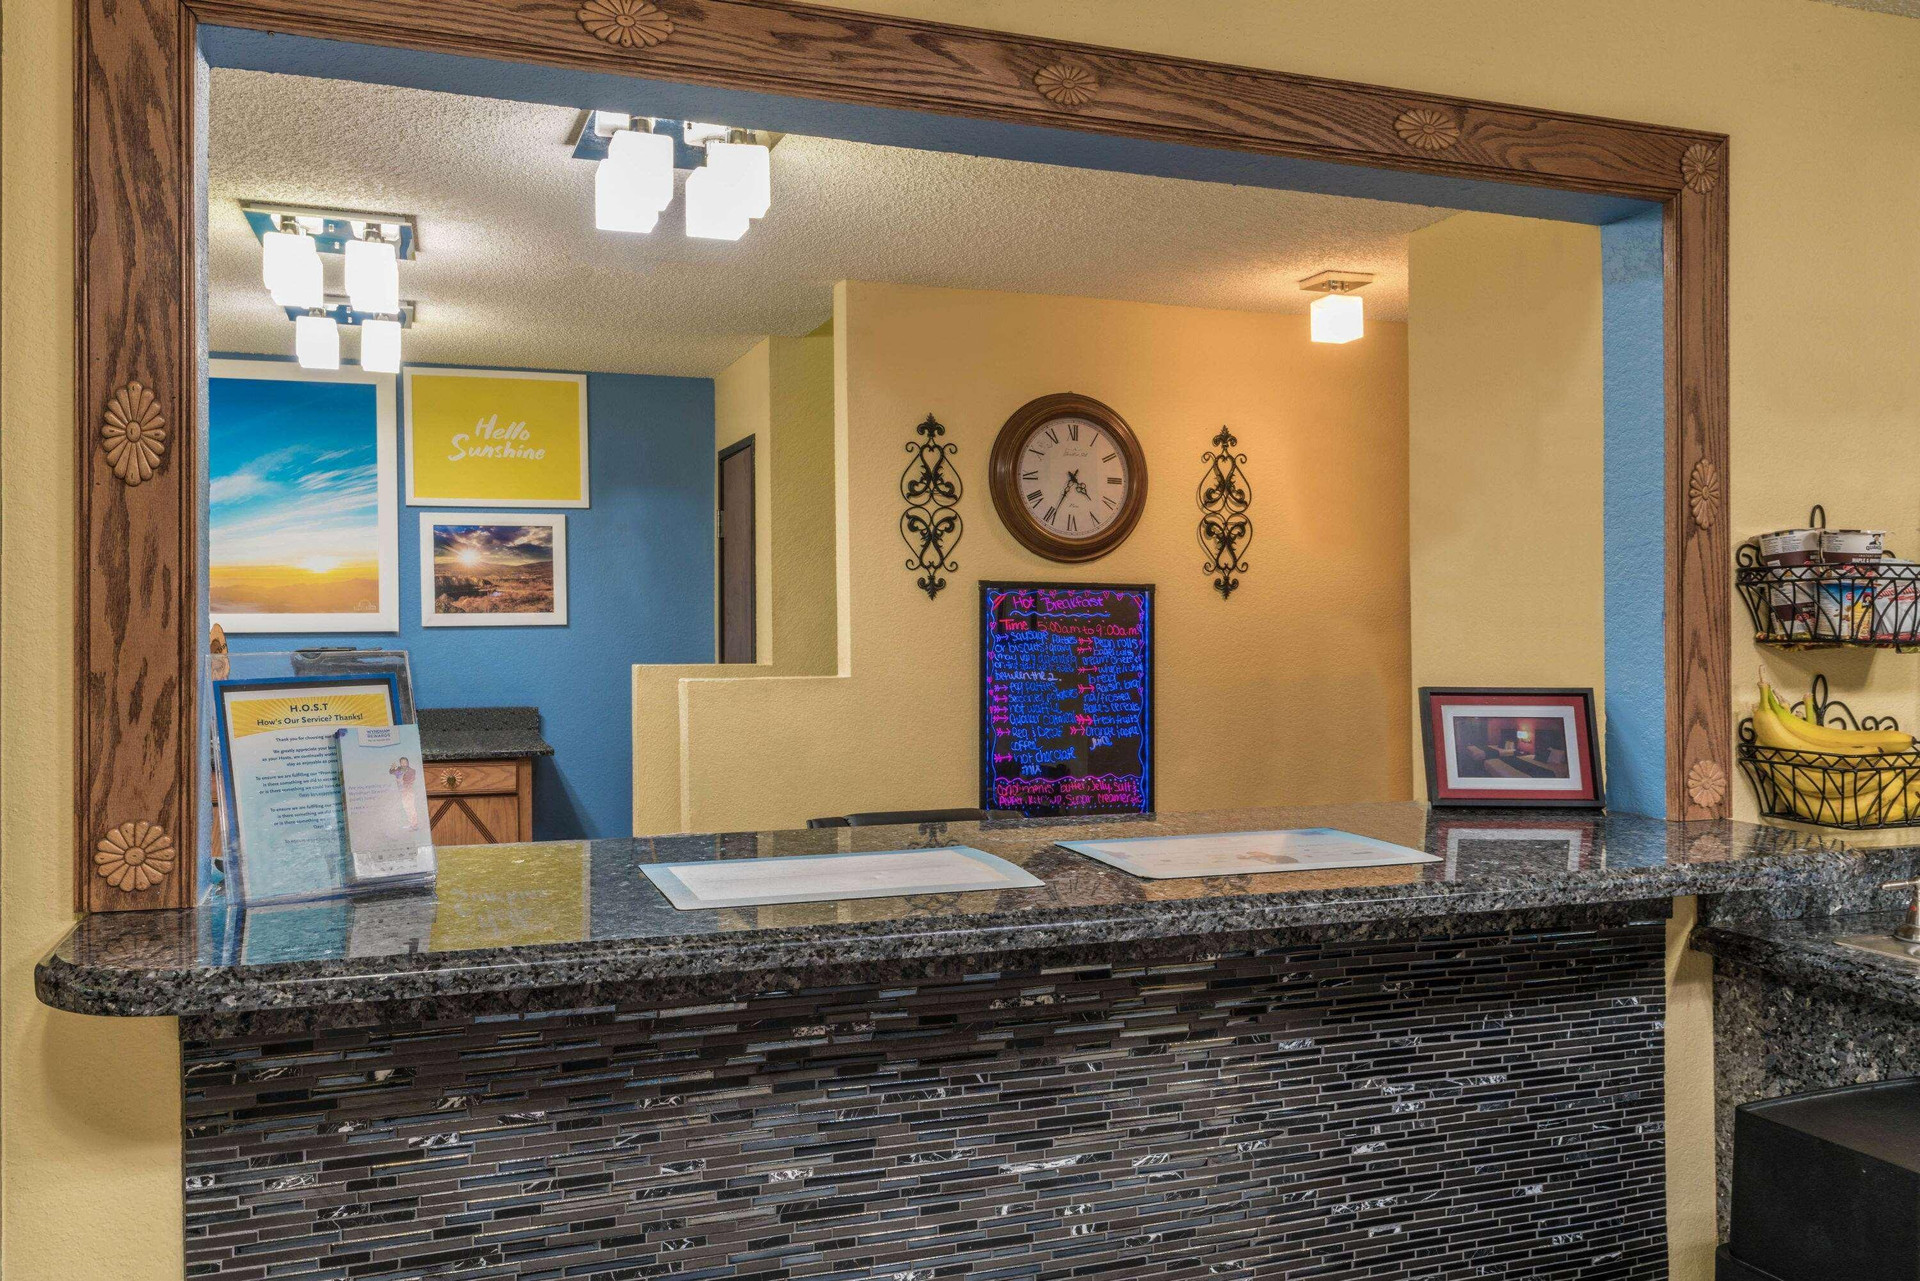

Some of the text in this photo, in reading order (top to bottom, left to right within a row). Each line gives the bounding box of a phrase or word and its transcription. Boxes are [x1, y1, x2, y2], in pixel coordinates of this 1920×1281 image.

[475, 414, 530, 441] Hello
[447, 434, 546, 462] Sunshine
[1013, 596, 1104, 611] Hot Breakfast
[999, 619, 1029, 631] Time
[1117, 637, 1139, 649] rolls
[290, 703, 328, 712] H.O.S.T
[302, 715, 332, 723] Service?
[334, 713, 363, 721] Thanks!
